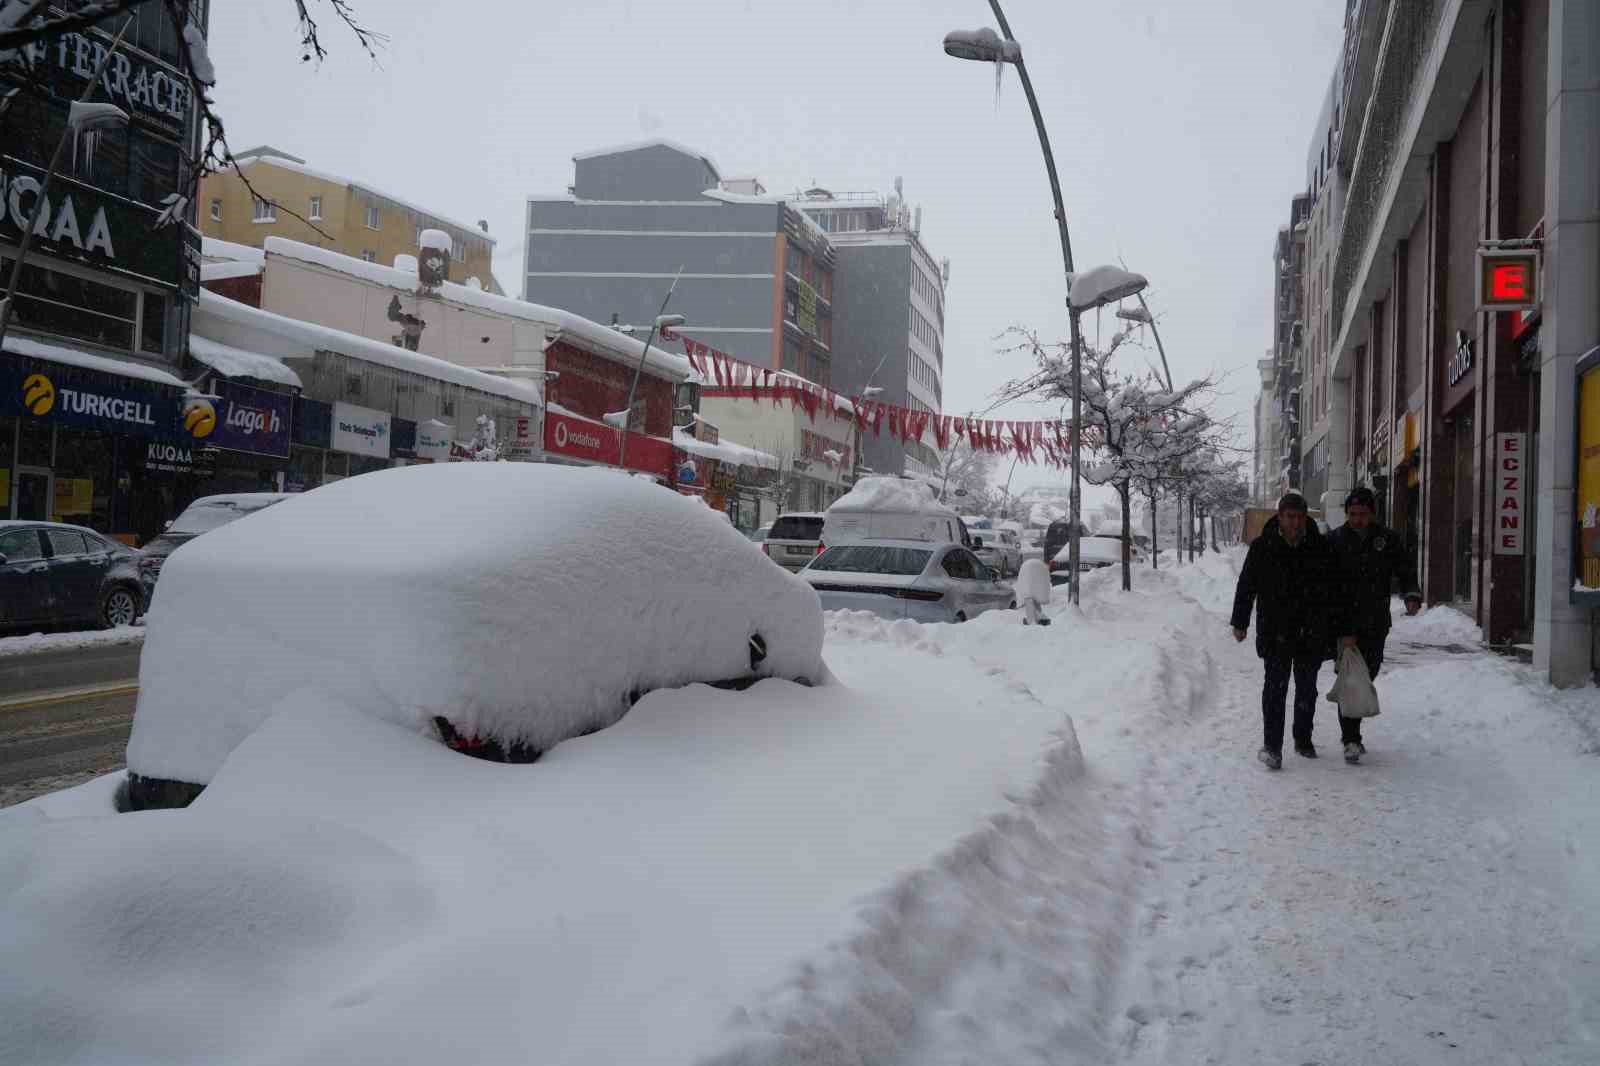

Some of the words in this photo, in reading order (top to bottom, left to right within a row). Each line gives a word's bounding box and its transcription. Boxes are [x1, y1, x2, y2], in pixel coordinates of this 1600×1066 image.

[56, 31, 186, 121] TERRACE
[1492, 264, 1525, 299] E
[59, 388, 156, 425] TURKCELL
[147, 442, 193, 464] KUQAA
[569, 430, 600, 449] vodafone
[1500, 438, 1519, 548] ECZANE
